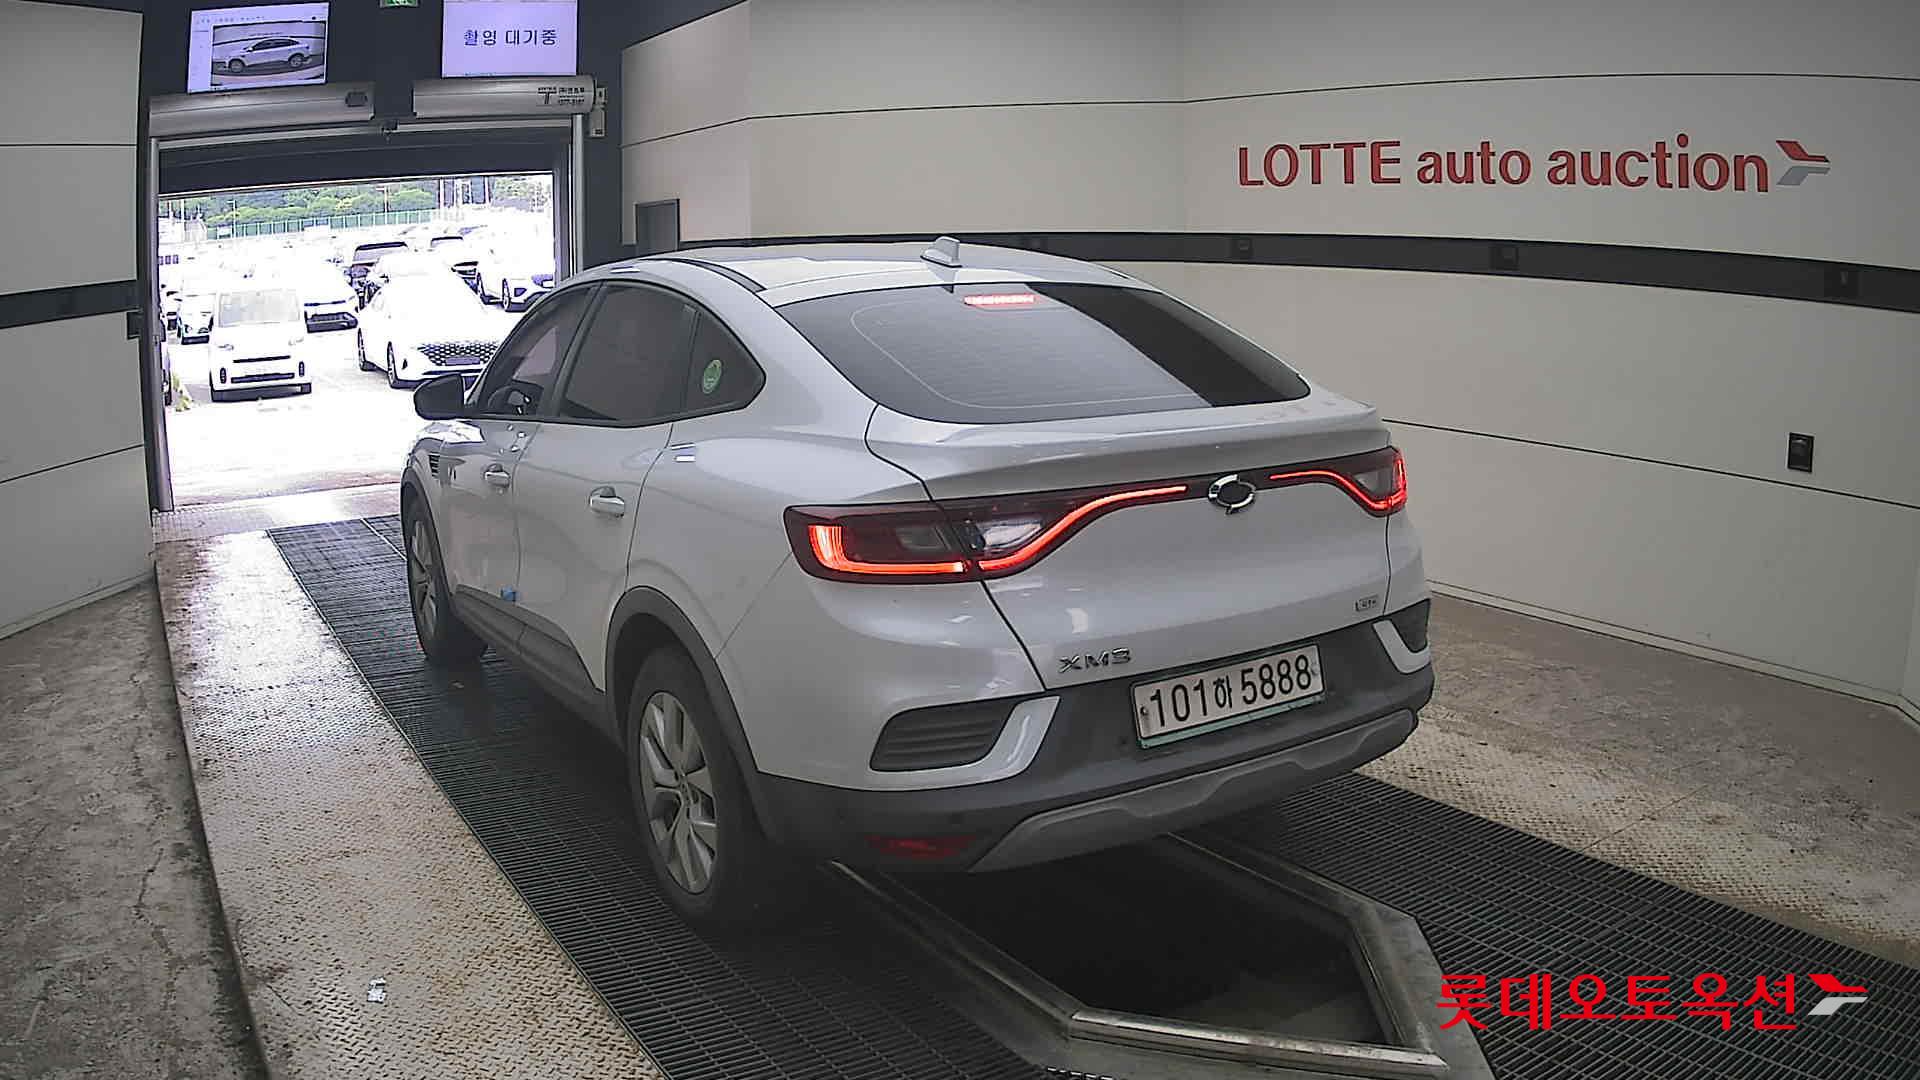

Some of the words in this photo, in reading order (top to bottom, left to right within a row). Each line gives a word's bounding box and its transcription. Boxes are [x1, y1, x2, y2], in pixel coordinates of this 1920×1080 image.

[505, 29, 557, 46] 대기중
[1238, 141, 1401, 187] LOTTE
[1416, 141, 1532, 186] auto
[1547, 134, 1769, 193] auction
[1058, 647, 1131, 673] XM3
